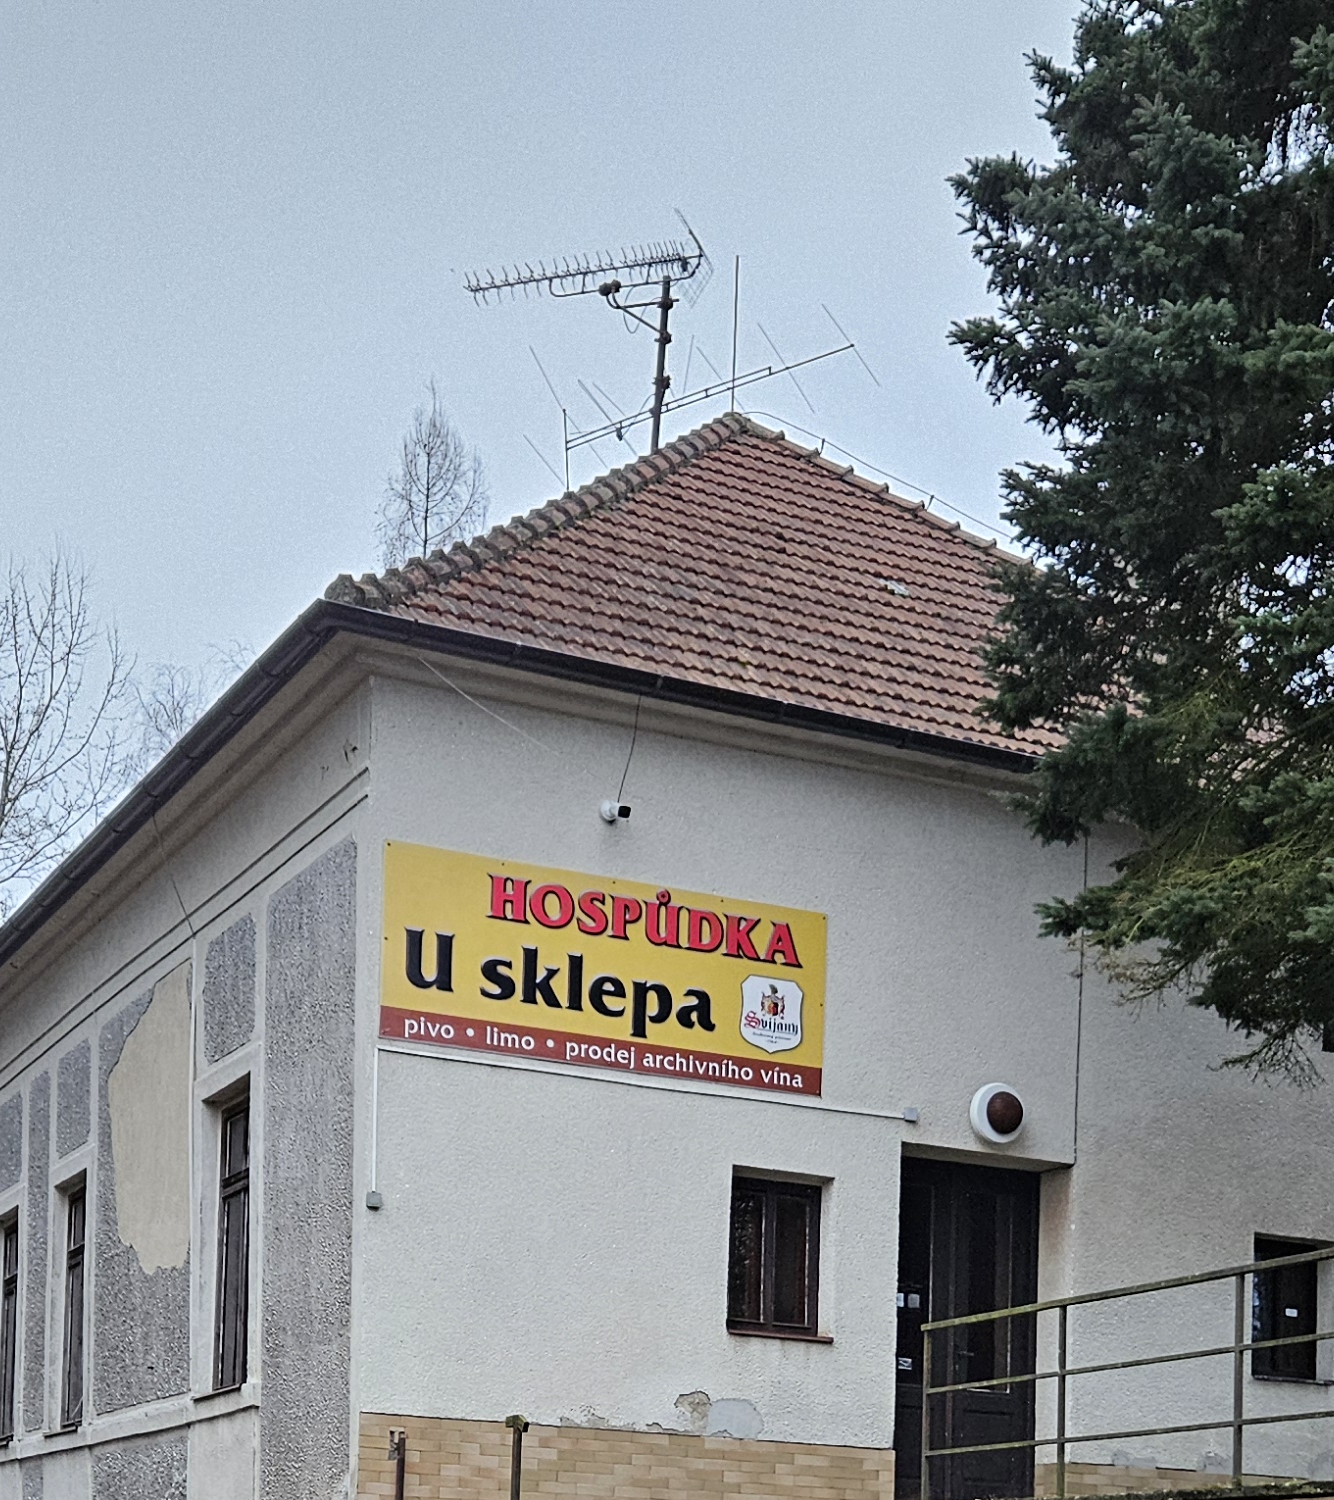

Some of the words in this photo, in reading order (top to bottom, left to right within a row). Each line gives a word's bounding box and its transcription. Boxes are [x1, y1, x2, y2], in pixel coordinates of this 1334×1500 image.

[487, 873, 803, 968] HOSPŮDKA
[480, 945, 716, 1038] sklepa
[404, 1016, 455, 1039] pivo
[486, 1026, 535, 1050] limo
[565, 1041, 635, 1069] prodej
[642, 1052, 753, 1081] archivního
[760, 1066, 803, 1088] vína
